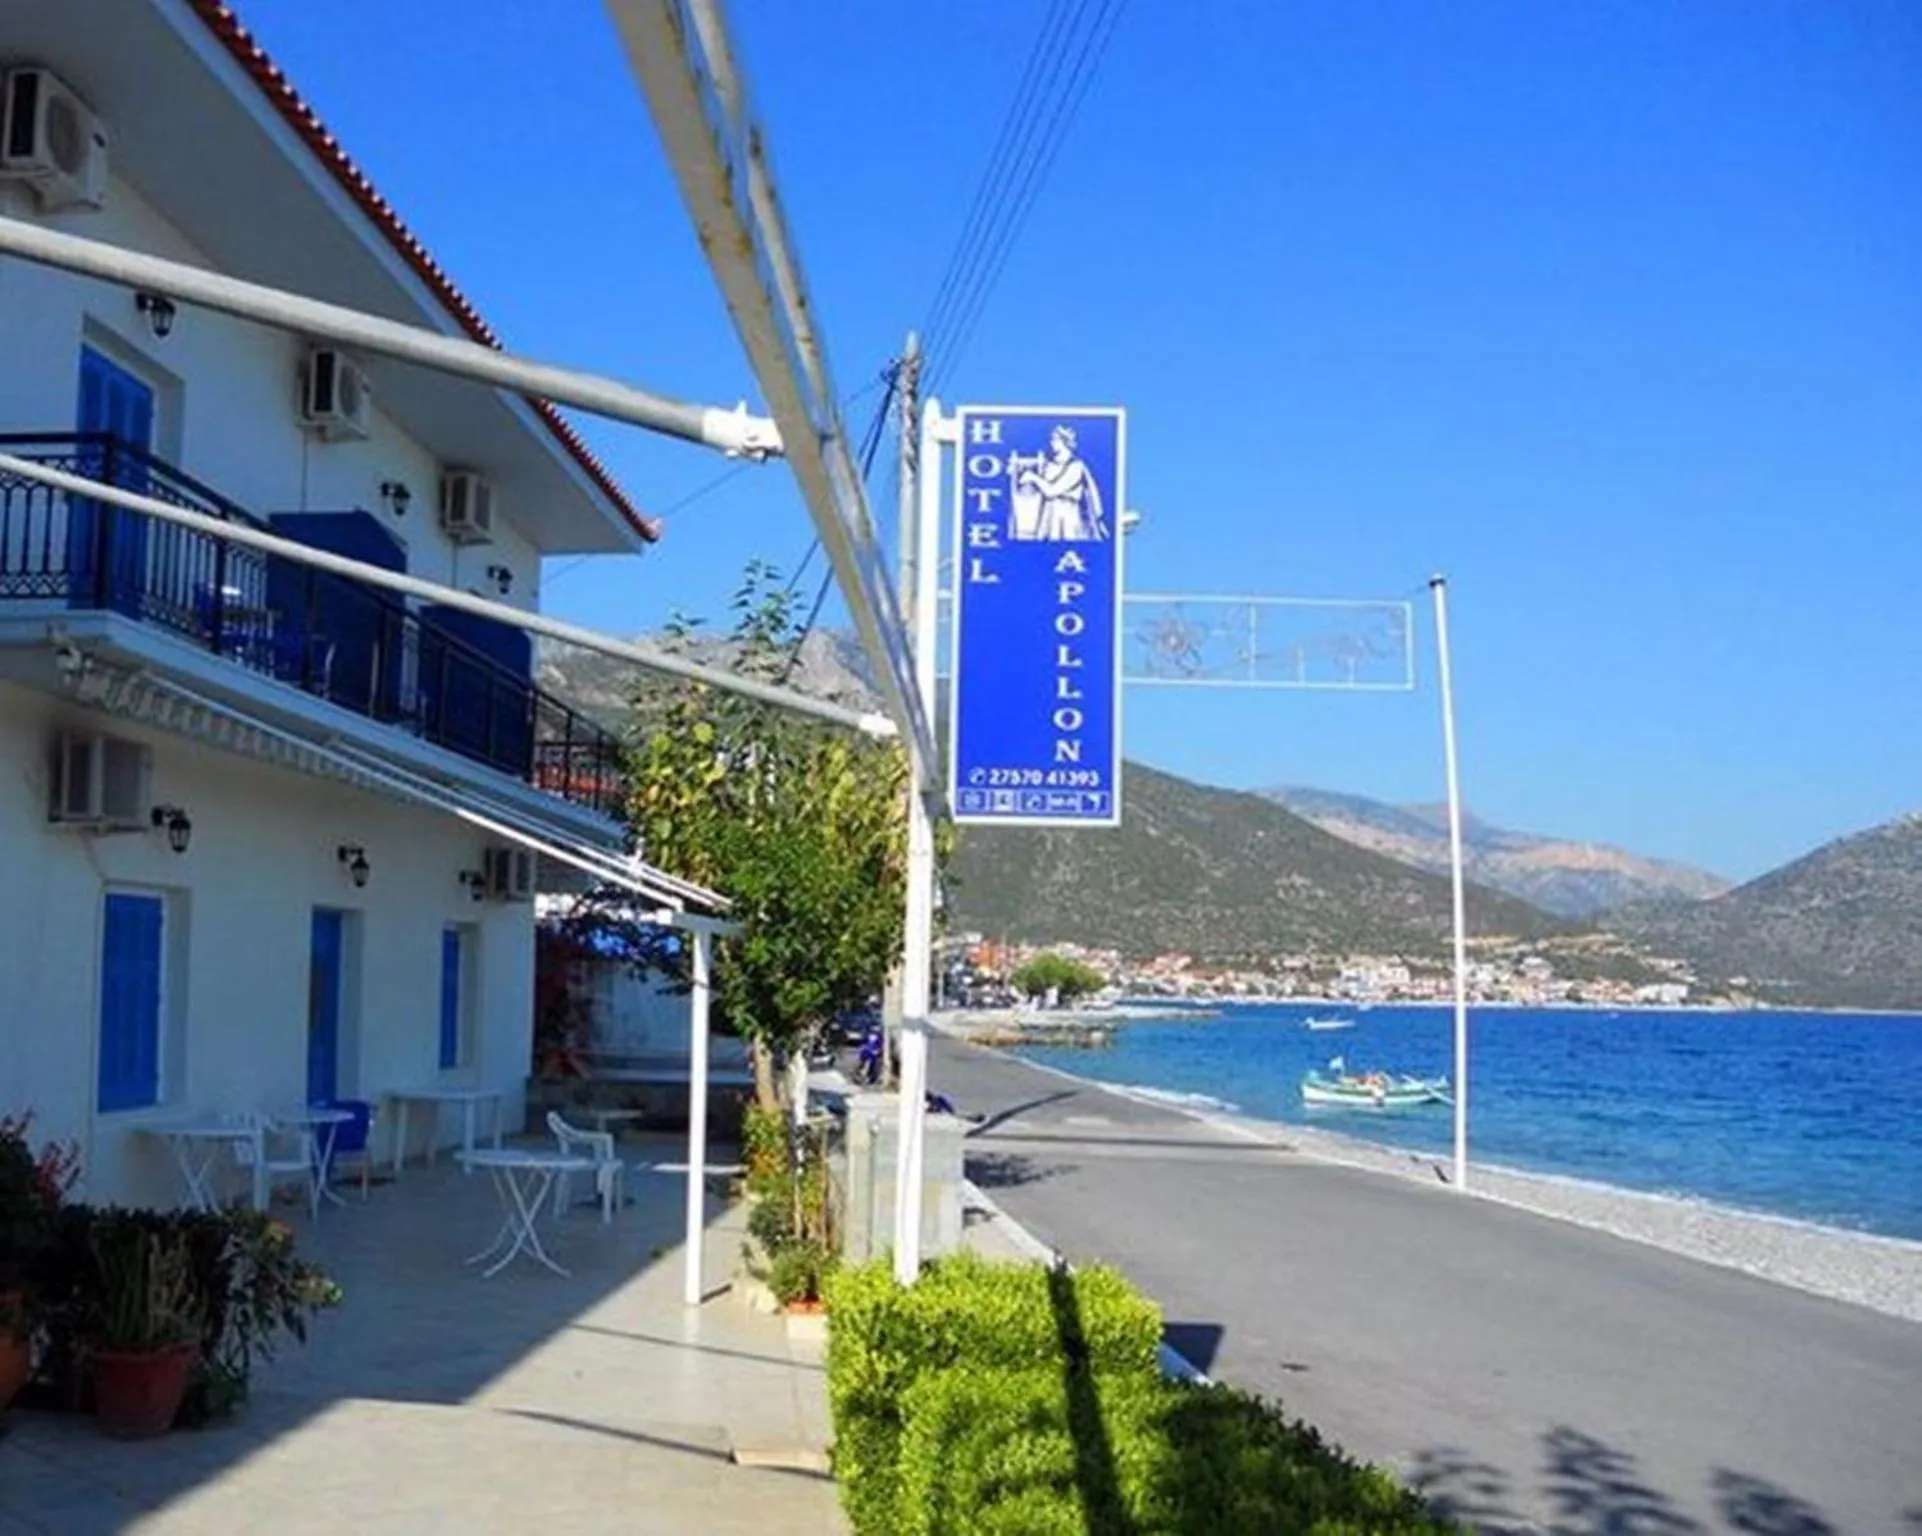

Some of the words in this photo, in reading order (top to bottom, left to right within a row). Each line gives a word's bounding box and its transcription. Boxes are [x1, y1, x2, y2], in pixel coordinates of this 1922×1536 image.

[967, 420, 1002, 584] HOTEL
[1053, 550, 1086, 762] APOLLON
[989, 768, 1043, 786] 27570
